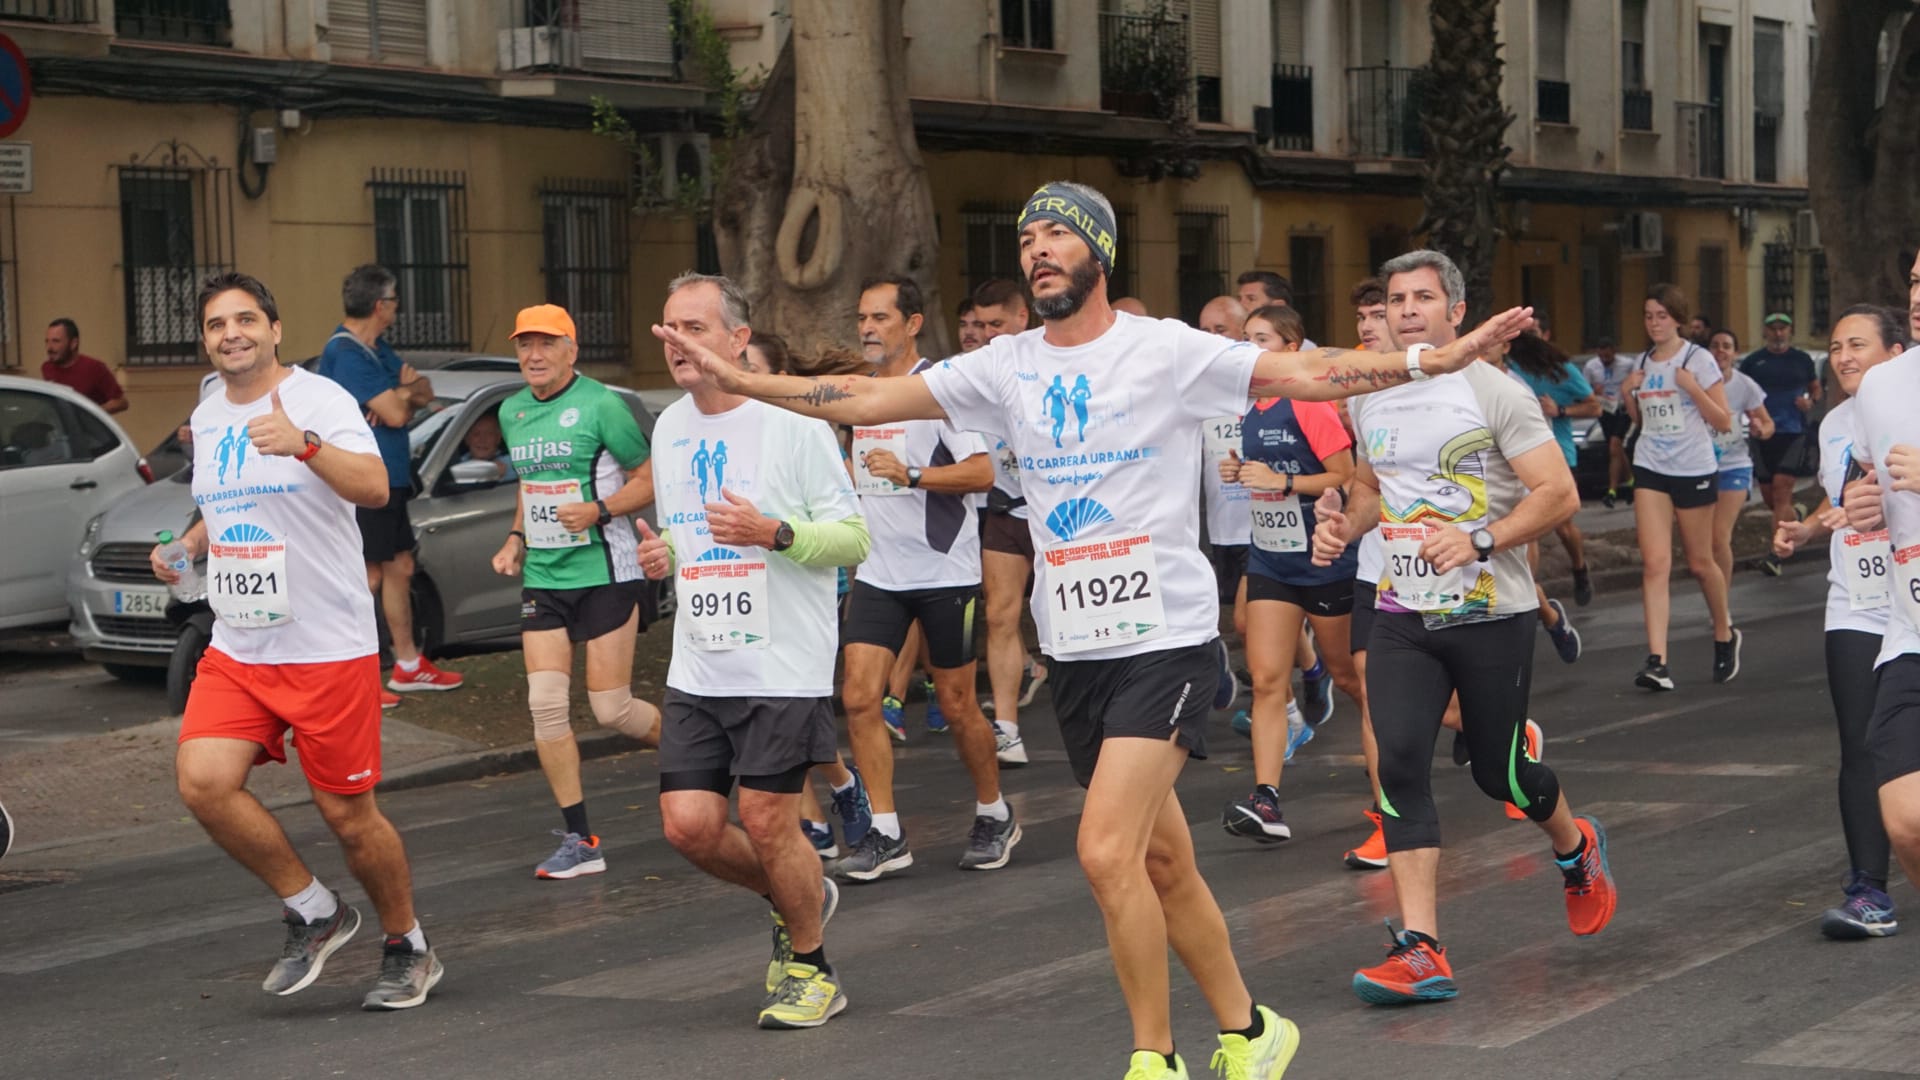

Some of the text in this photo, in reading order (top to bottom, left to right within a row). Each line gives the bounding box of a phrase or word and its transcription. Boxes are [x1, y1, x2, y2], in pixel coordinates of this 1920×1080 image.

[1646, 403, 1675, 418] 1761
[511, 437, 572, 462] mijas
[1037, 454, 1088, 469] CARRERA
[1090, 449, 1140, 464] URBANA
[206, 488, 243, 502] CARRERA
[244, 484, 284, 496] URBANA
[672, 512, 685, 524] 42
[1252, 511, 1298, 528] 13820
[1045, 550, 1066, 567] 42
[1065, 543, 1107, 556] CARRERA
[1109, 535, 1150, 549] URBANA
[1090, 547, 1131, 561] MALAGA
[681, 566, 700, 580] 42
[1858, 555, 1889, 578] 98
[214, 571, 277, 595] 11821
[1056, 570, 1151, 611] 11922
[125, 594, 162, 612] 2854
[691, 591, 752, 617] 9916
